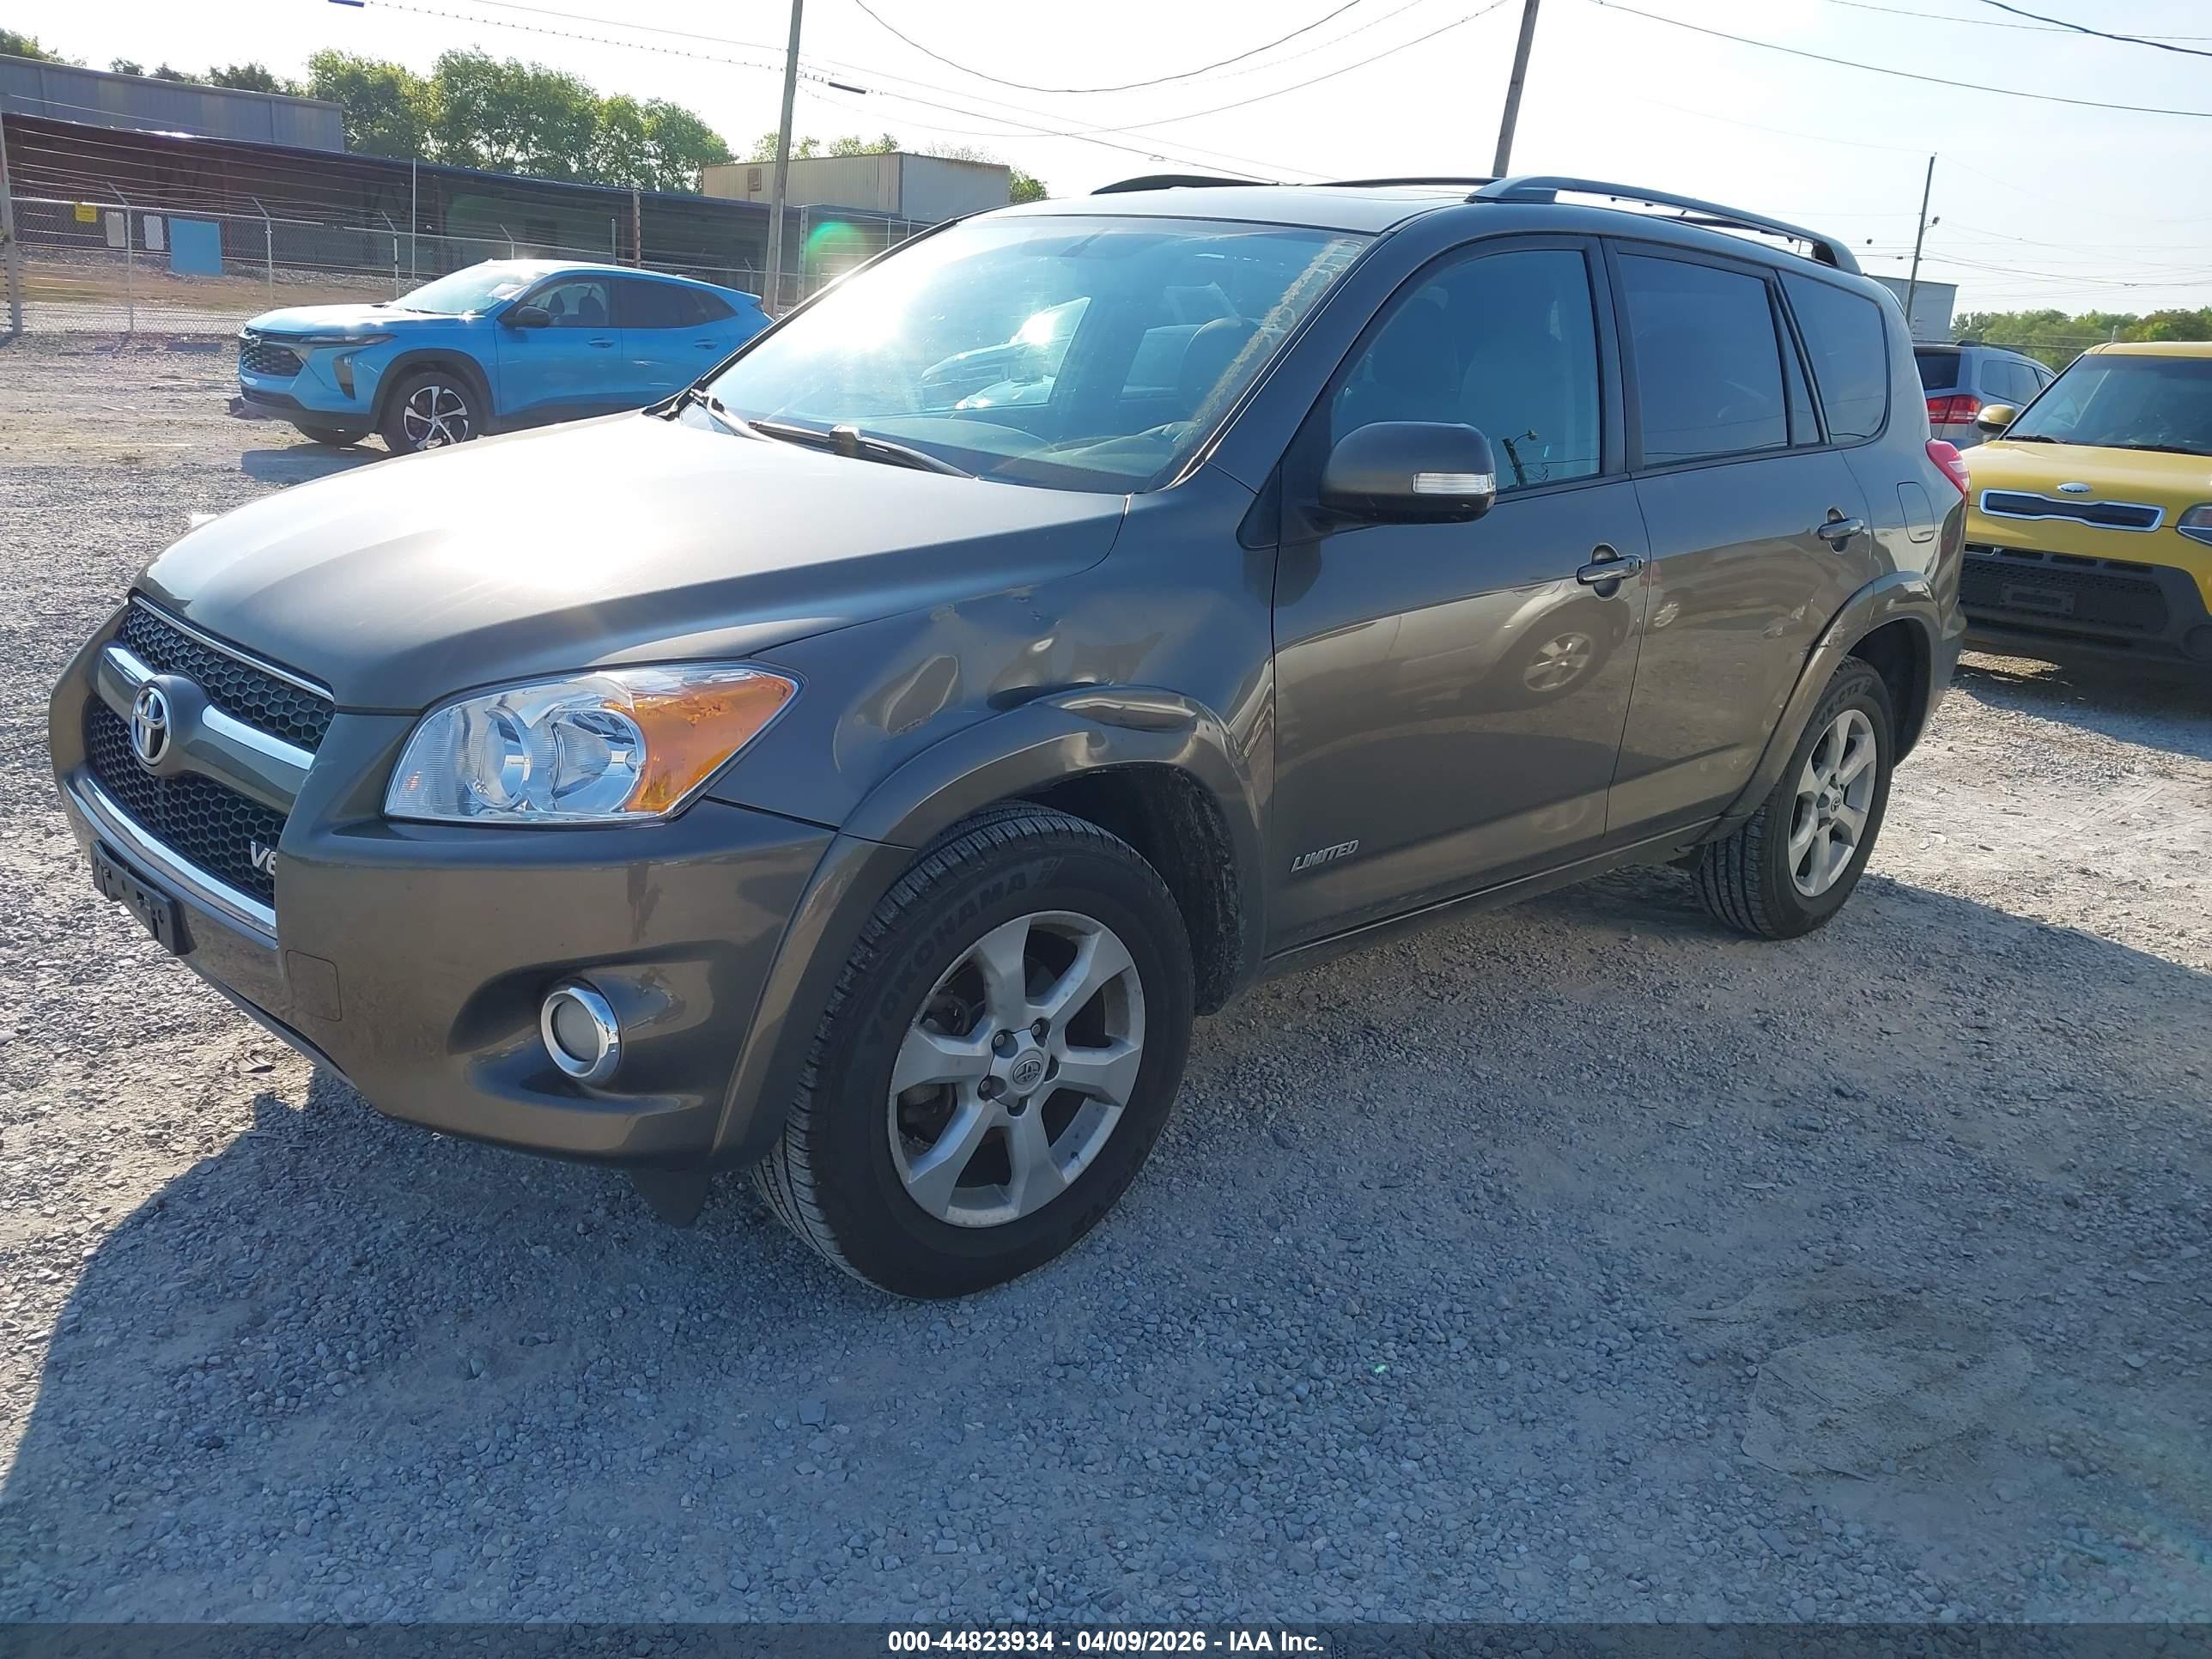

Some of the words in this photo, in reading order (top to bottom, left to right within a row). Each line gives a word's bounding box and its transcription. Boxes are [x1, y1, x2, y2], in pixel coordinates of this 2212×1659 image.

[250, 840, 276, 876] V6
[1289, 839, 1359, 872] LIMITED
[865, 871, 1028, 1047] YOKOHAMA
